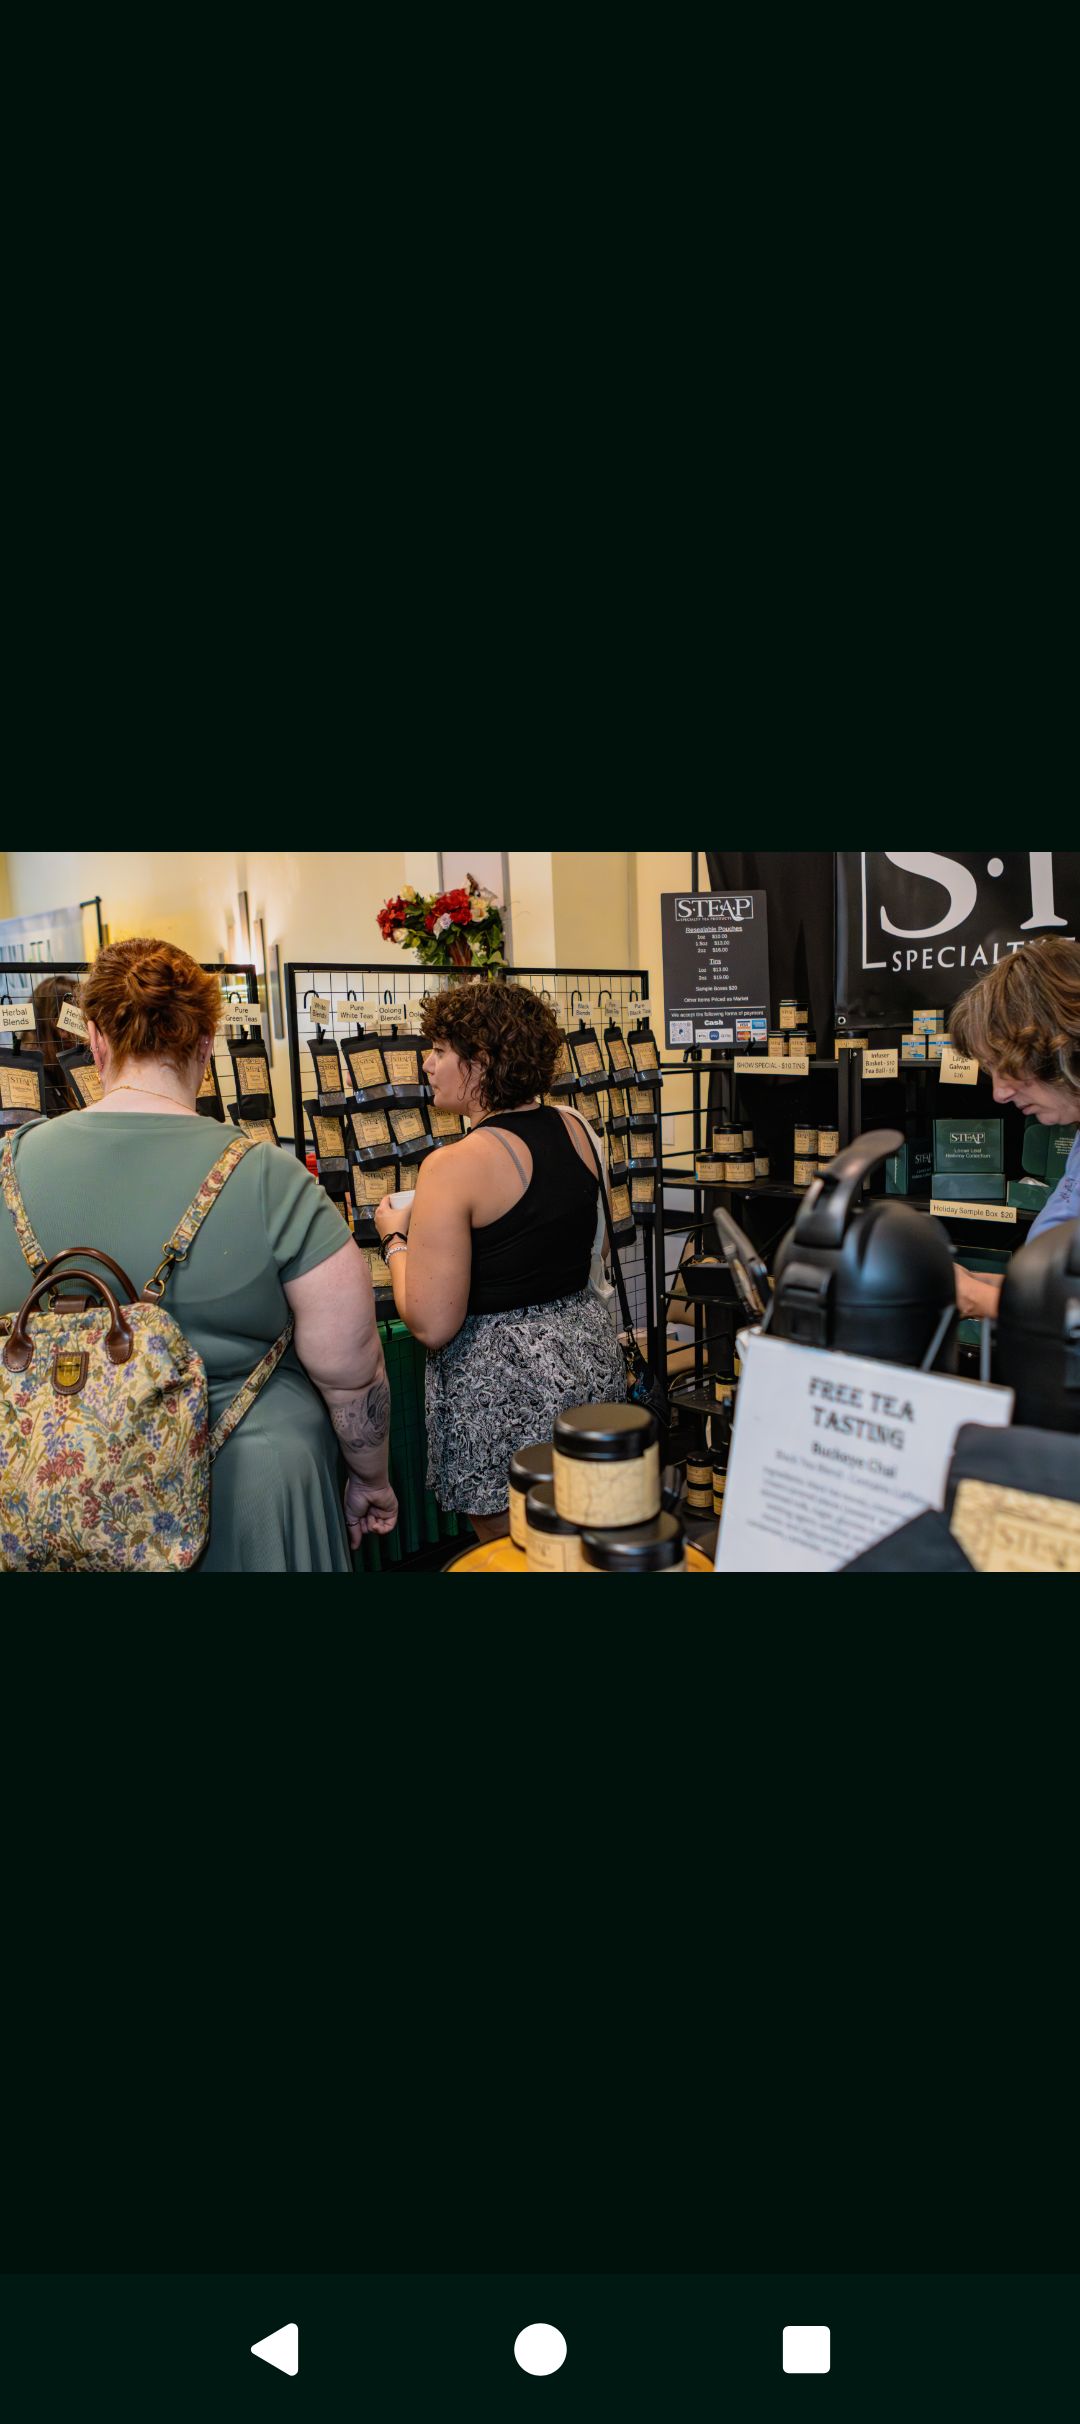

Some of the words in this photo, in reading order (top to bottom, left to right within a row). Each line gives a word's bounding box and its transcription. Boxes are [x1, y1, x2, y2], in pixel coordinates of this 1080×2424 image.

[4, 1018, 29, 1026] Blends
[933, 1204, 958, 1214] Holiday
[959, 1207, 984, 1217] Sample
[809, 1377, 863, 1408] FREE
[871, 1391, 914, 1423] TEA
[813, 1405, 905, 1450] TASTING
[812, 1441, 864, 1469] Buckeye
[867, 1458, 897, 1477] Chai
